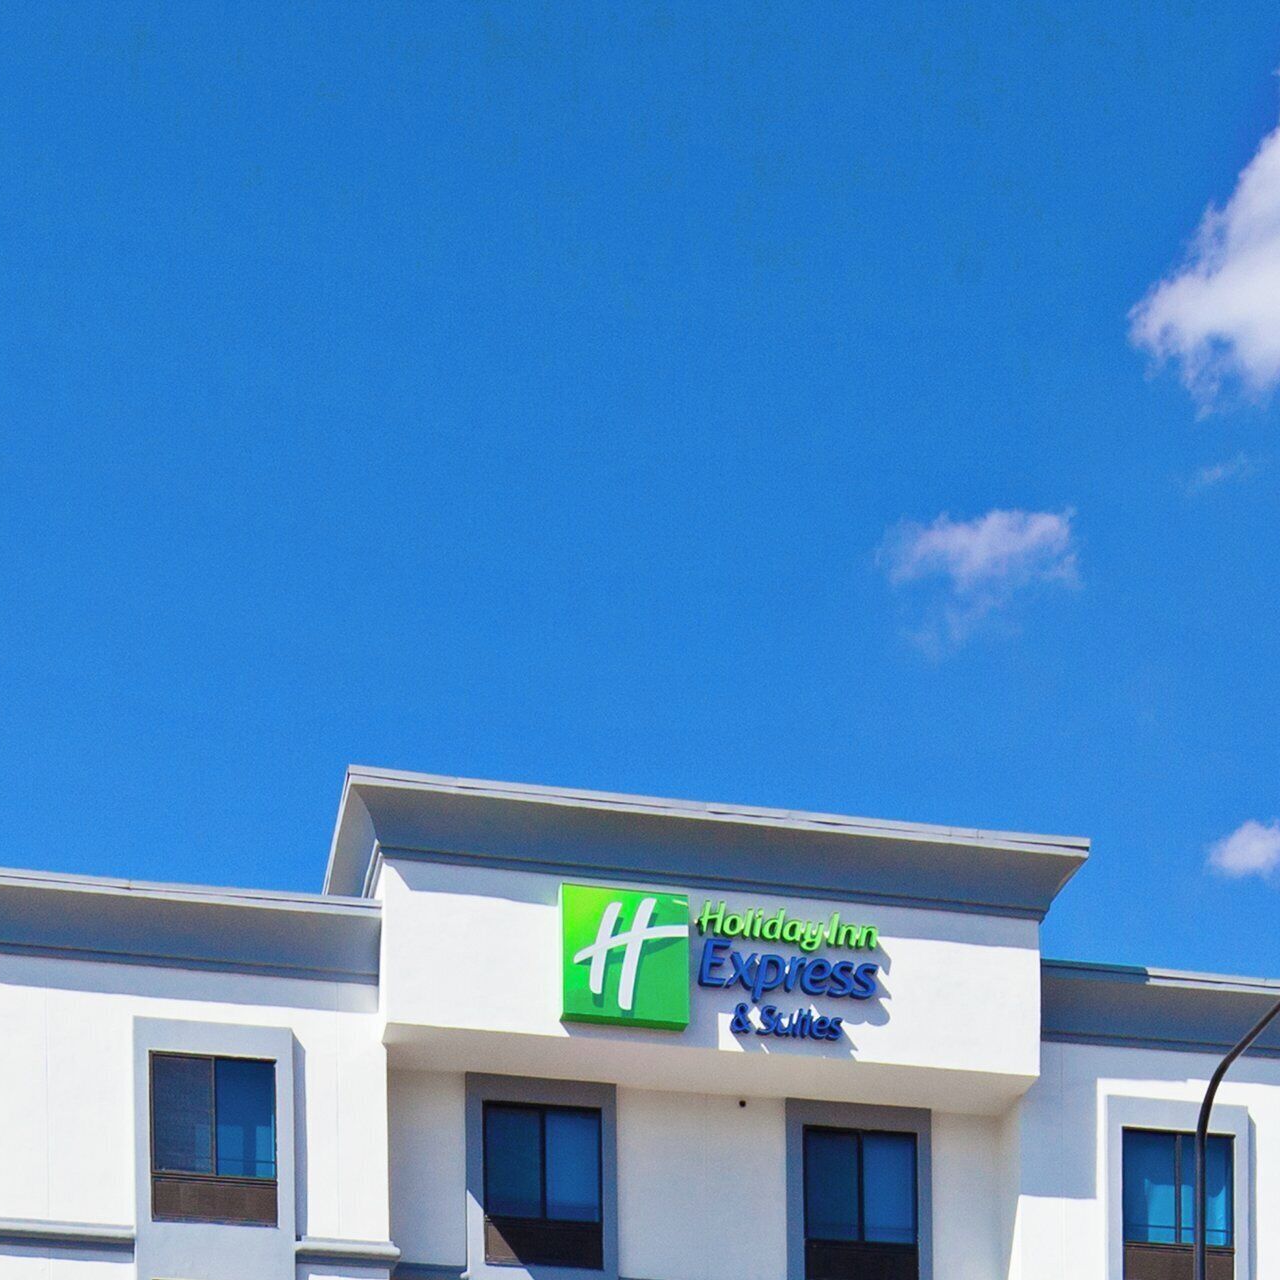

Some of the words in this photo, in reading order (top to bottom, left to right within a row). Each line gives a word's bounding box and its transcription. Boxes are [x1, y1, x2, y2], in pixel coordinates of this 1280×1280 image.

[697, 899, 824, 953] Holiday
[826, 912, 879, 950] Inn
[698, 938, 879, 1003] Express
[730, 1002, 752, 1034] &
[755, 1004, 843, 1041] Suites
